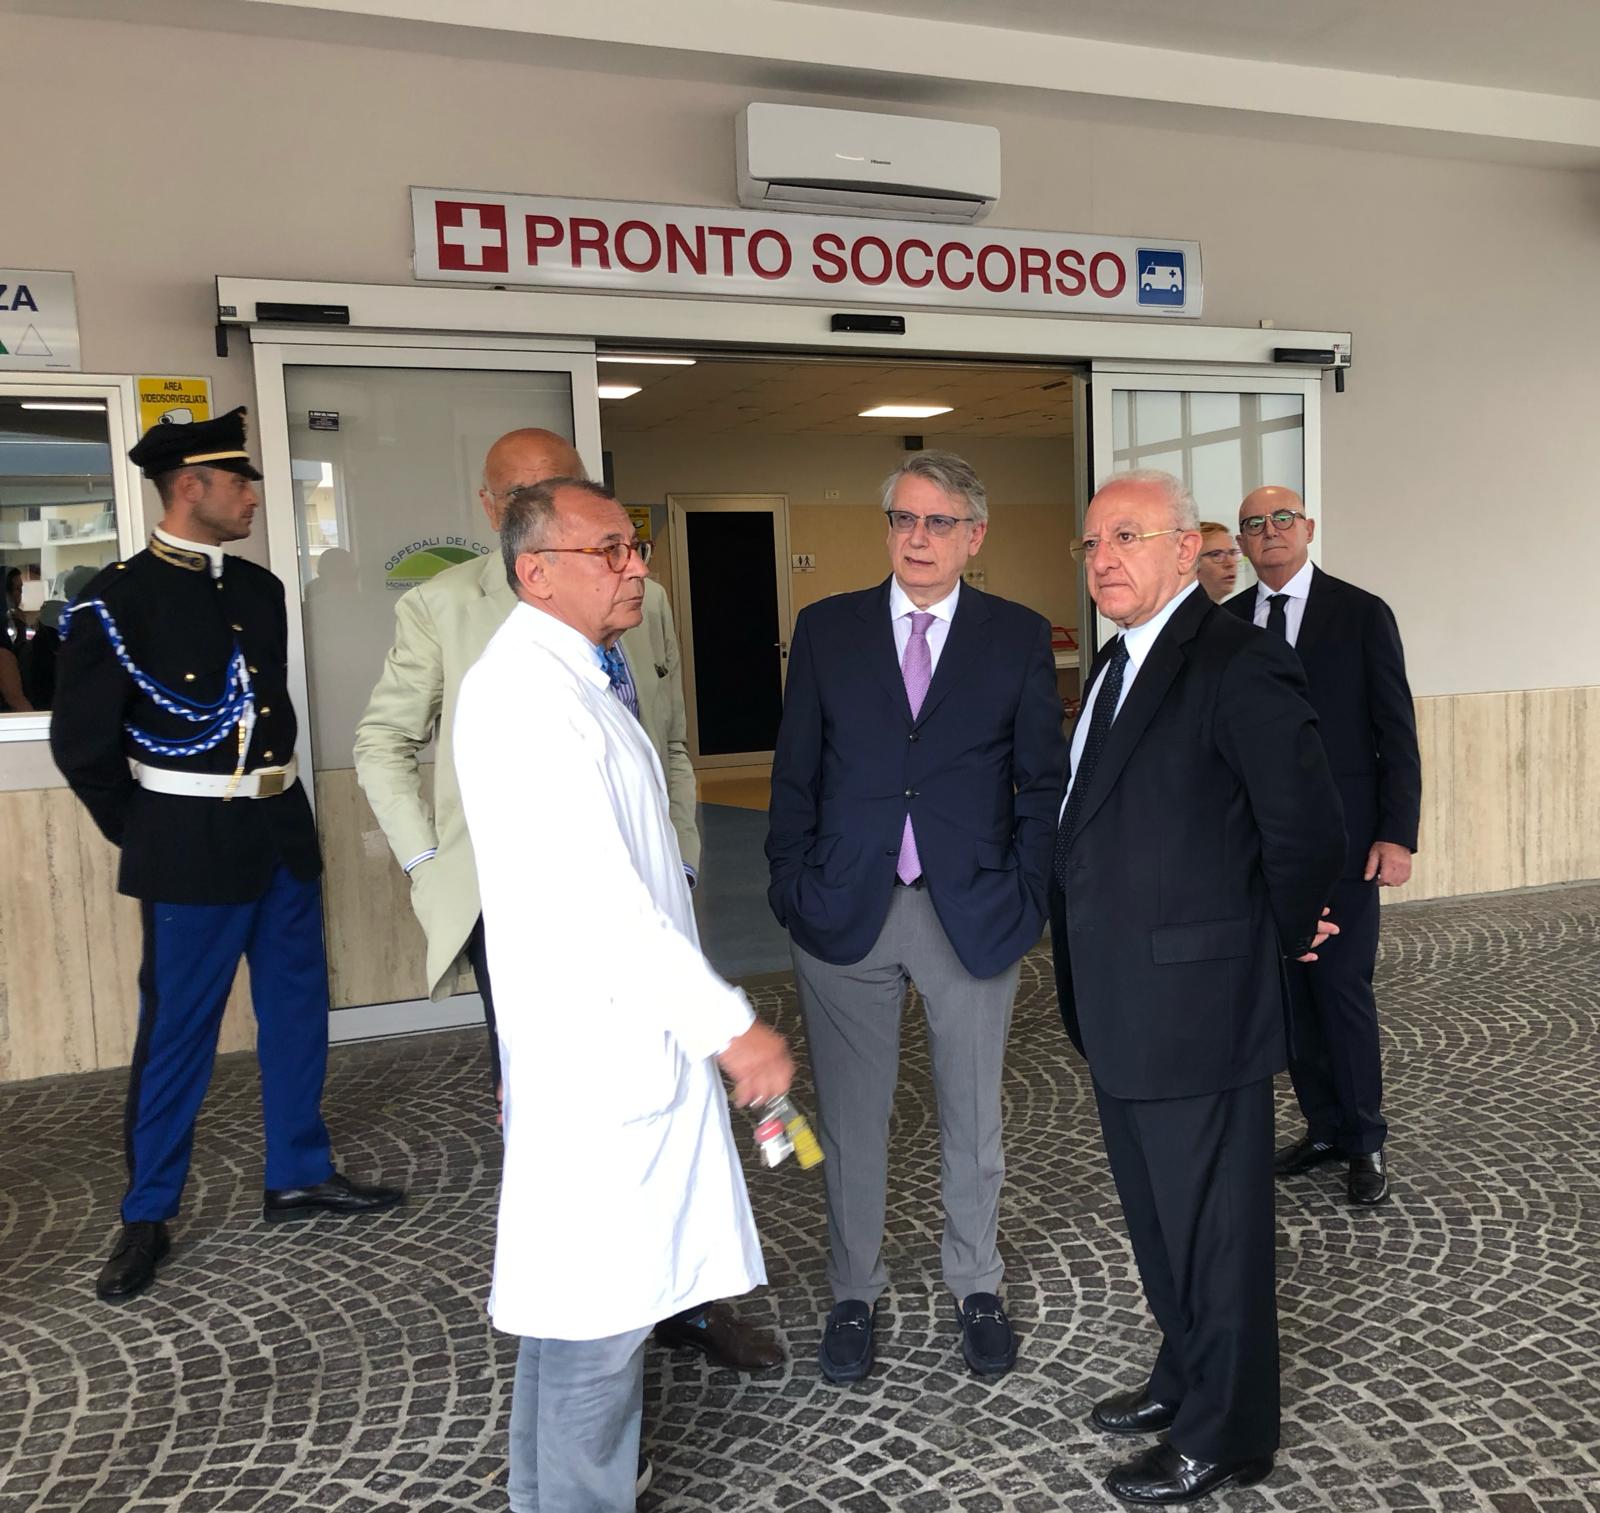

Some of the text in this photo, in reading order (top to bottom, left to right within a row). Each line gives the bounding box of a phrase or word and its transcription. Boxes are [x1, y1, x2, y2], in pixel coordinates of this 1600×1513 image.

[525, 215, 1126, 298] PRONTO SOCCORSO
[163, 381, 183, 391] AREA
[141, 393, 207, 404] VIDEOSORVEGLIATA
[384, 536, 494, 571] OSPEDALI DEI CO
